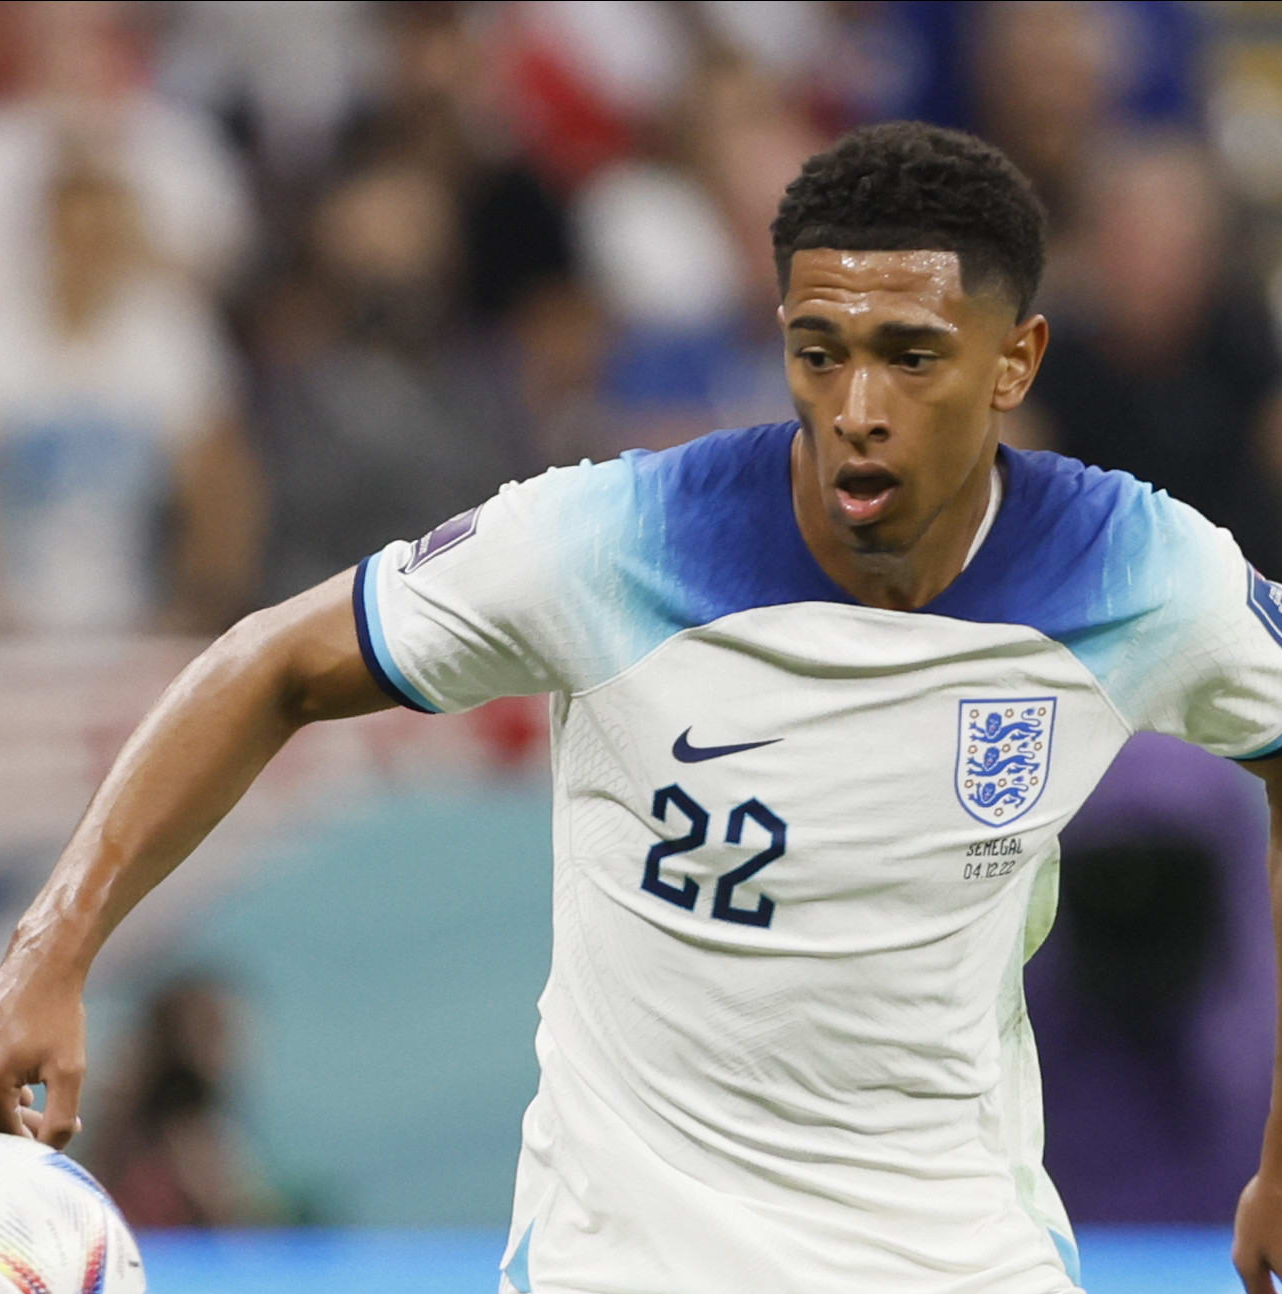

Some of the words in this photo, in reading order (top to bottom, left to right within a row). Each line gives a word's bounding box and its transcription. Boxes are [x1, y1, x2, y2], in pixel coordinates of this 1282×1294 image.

[640, 782, 788, 930] 22
[966, 837, 1023, 856] SENEGAL
[963, 860, 1016, 880] 04.12.22
